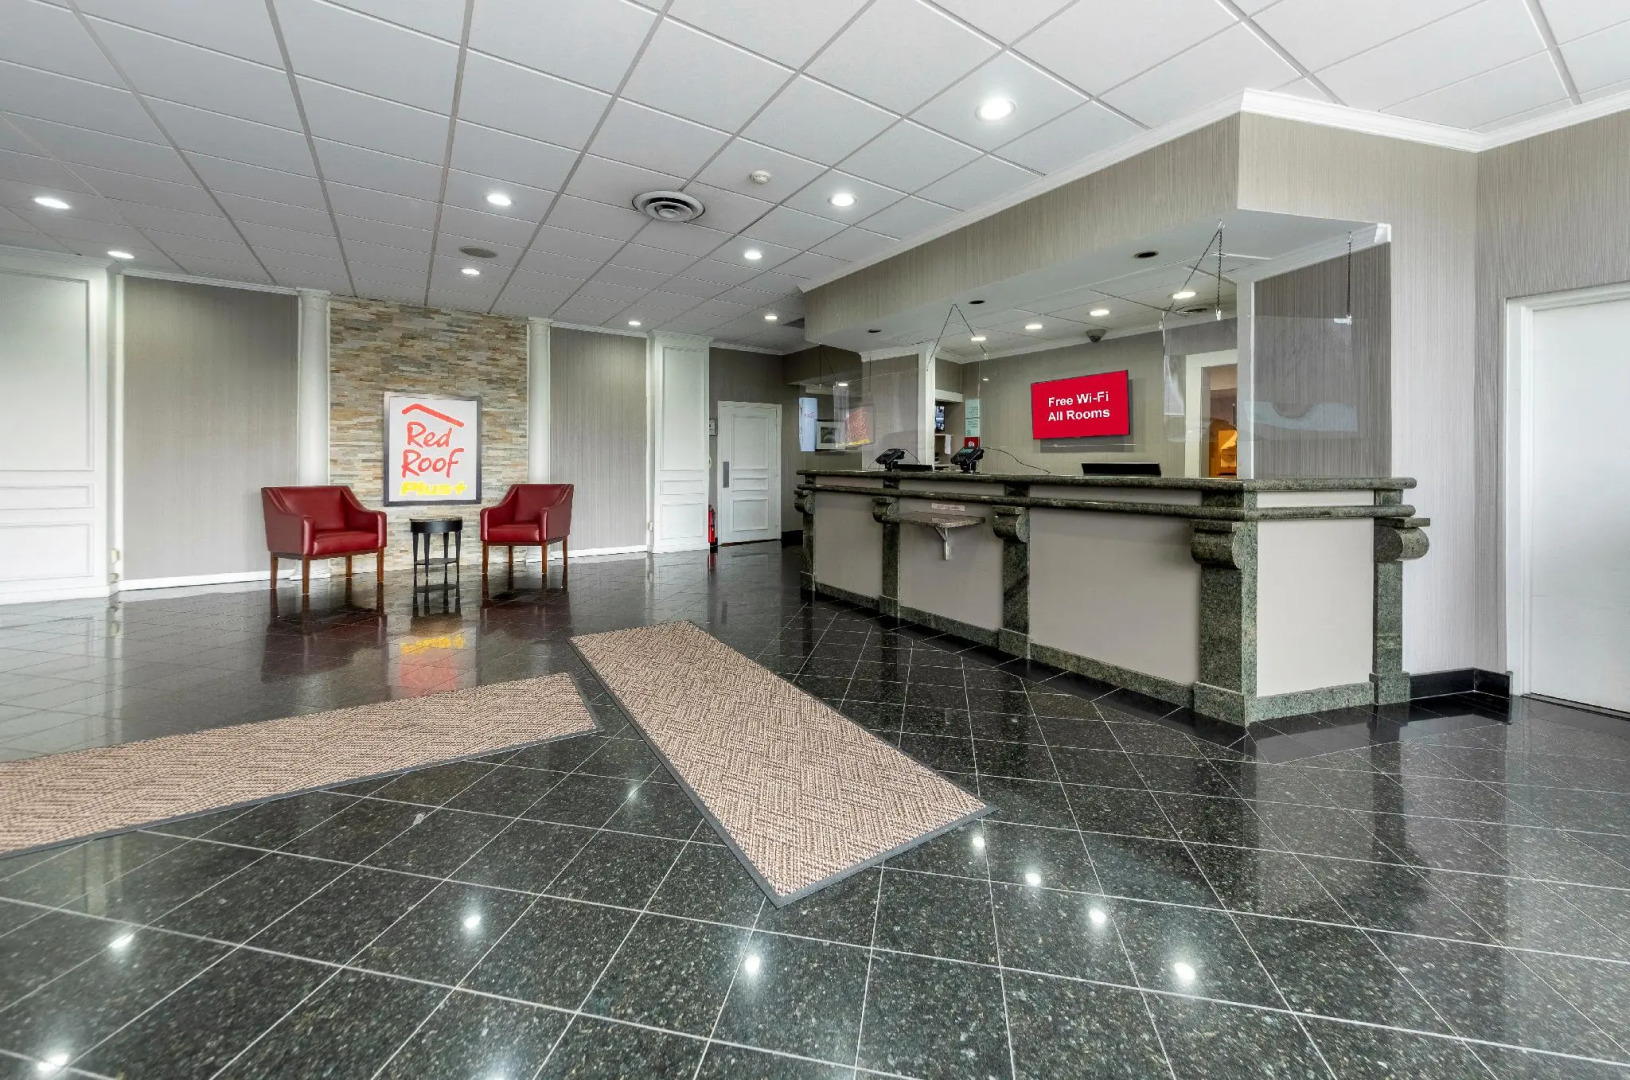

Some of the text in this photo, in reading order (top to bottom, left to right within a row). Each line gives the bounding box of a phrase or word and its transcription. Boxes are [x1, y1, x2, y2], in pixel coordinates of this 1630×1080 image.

[1048, 391, 1109, 407] Free Wi-Fi
[1048, 409, 1110, 421] All Rooms
[407, 421, 452, 448] Red
[401, 447, 464, 478] Roof
